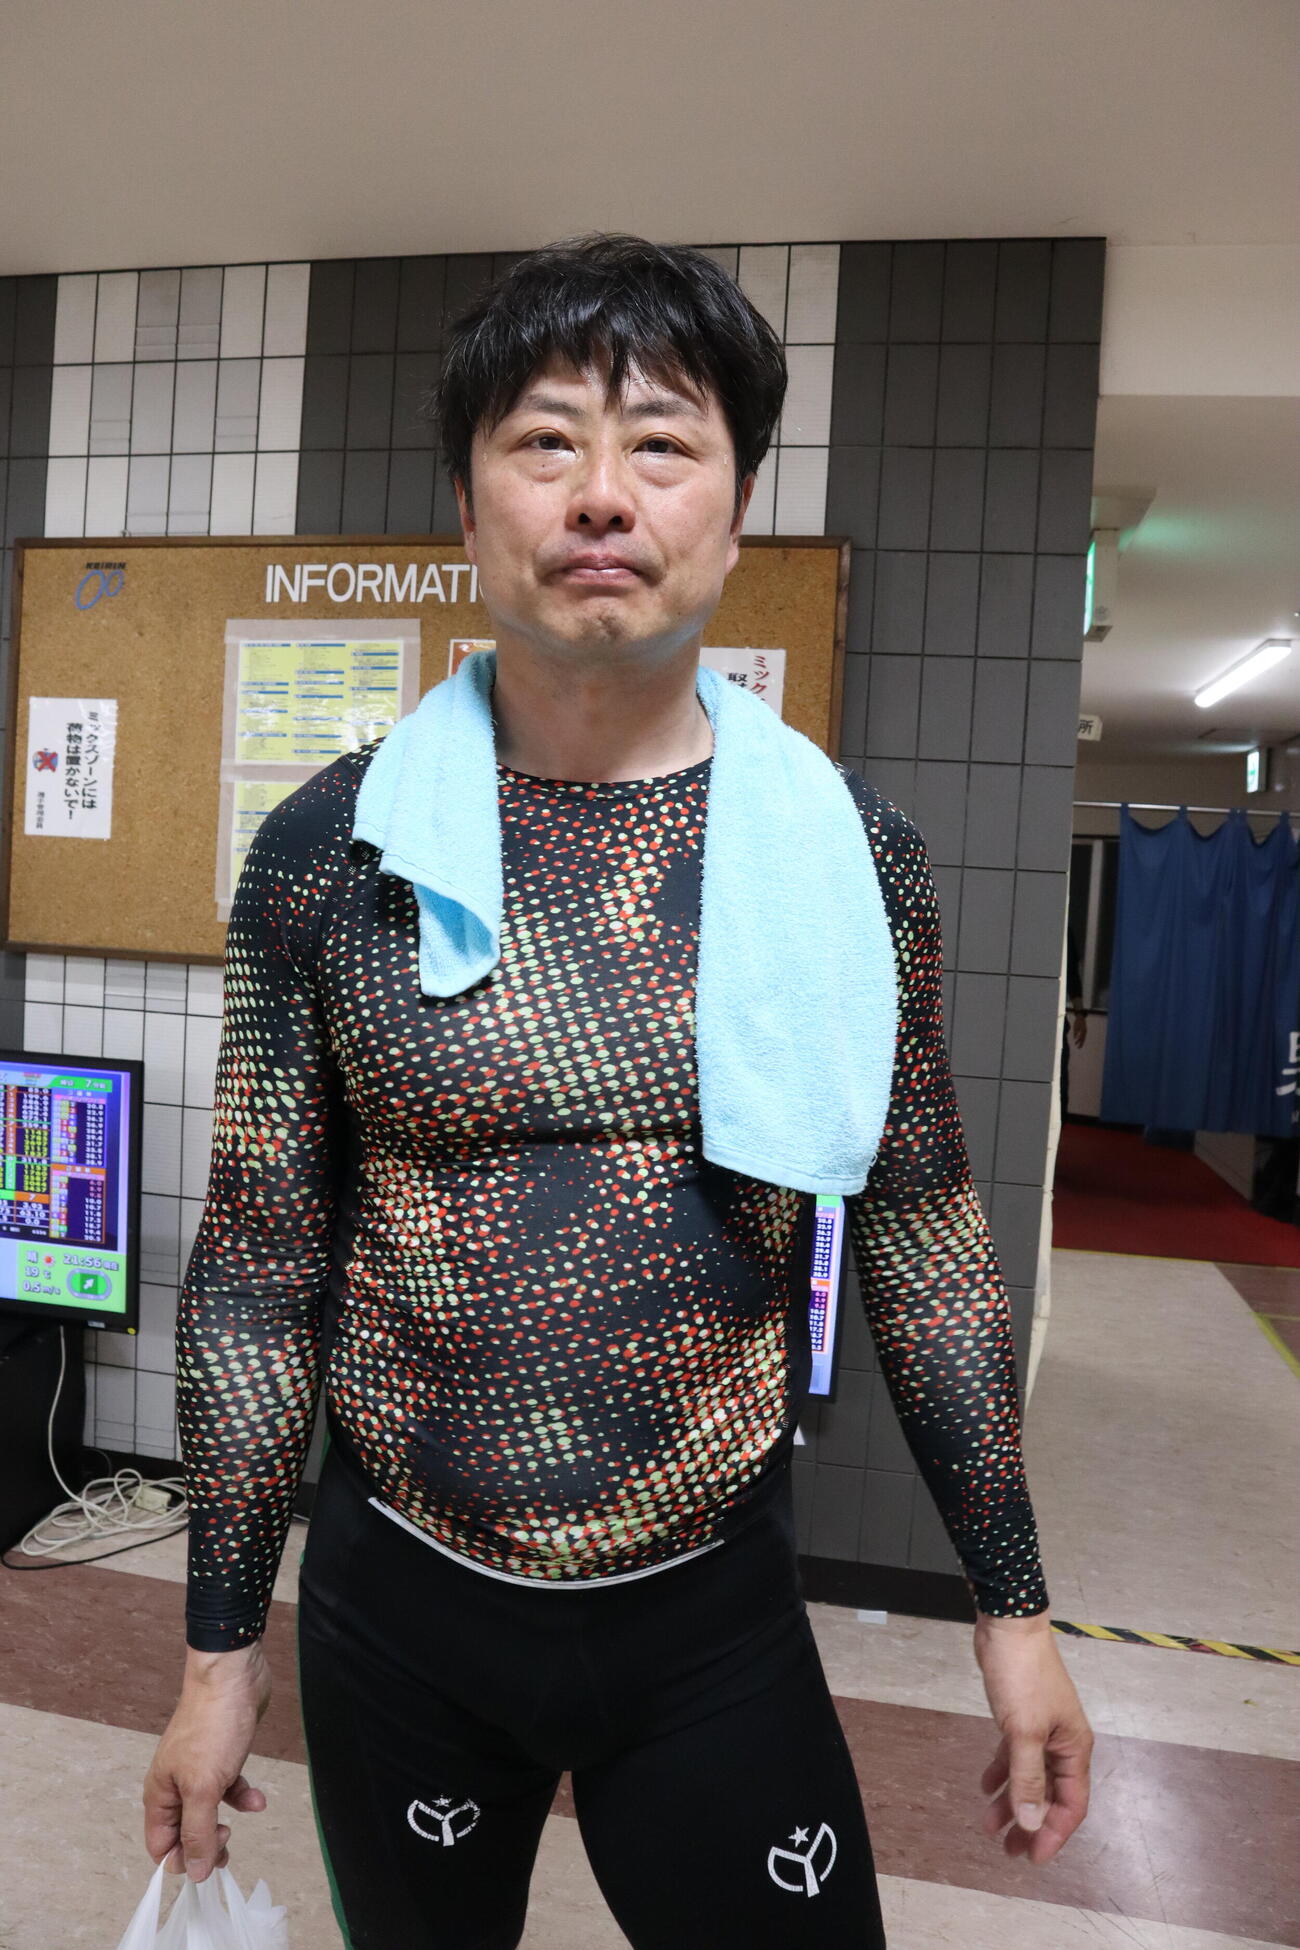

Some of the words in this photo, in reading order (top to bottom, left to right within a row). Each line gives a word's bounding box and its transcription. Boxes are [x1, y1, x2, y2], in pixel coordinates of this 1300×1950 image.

[265, 562, 484, 603] INFORMATI
[750, 655, 770, 701] ミック
[82, 711, 101, 809] ミックスゾーンには
[23, 1280, 41, 1293] 0.5
[25, 1266, 39, 1278] 19
